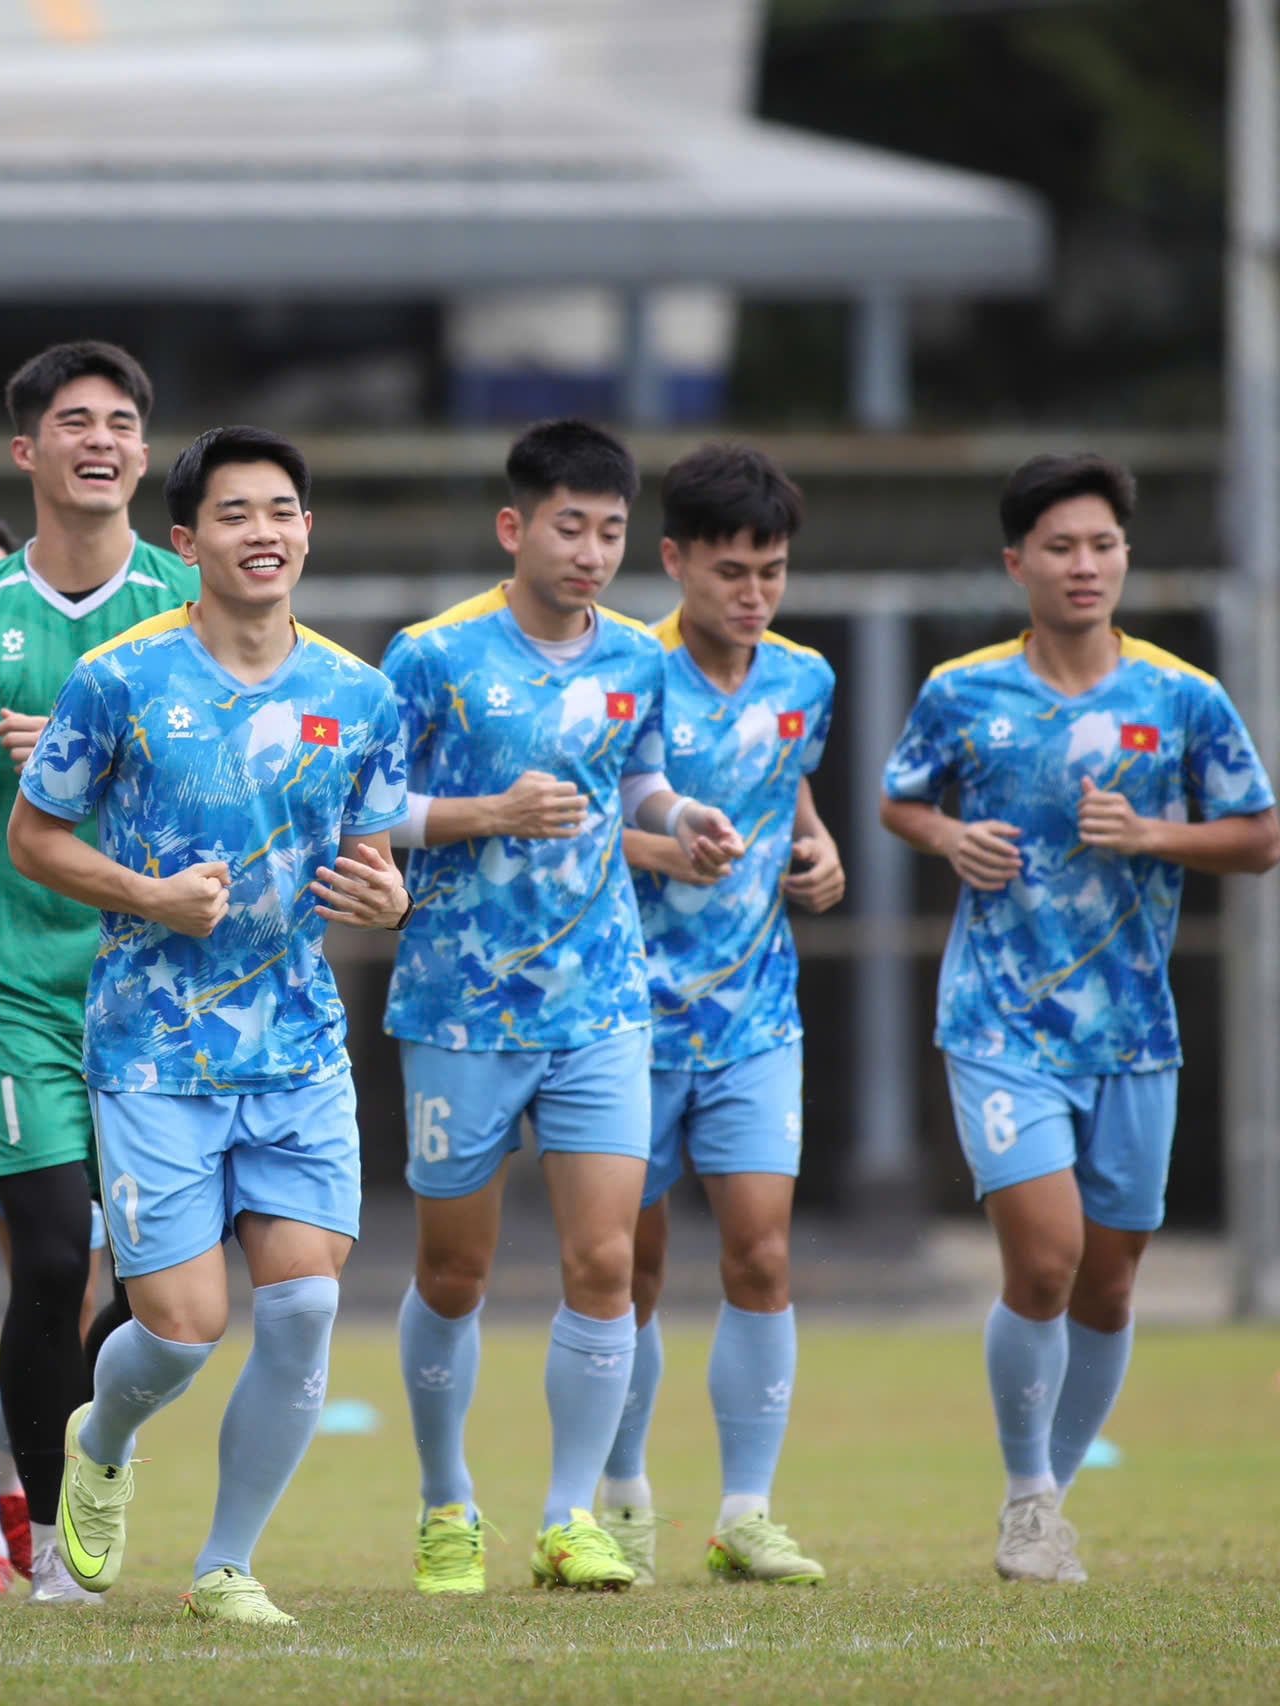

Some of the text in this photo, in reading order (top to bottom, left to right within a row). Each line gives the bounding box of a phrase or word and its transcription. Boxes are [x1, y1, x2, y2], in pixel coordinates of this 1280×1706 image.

[0, 1075, 20, 1145] 1
[412, 1091, 451, 1163] 16
[982, 1089, 1017, 1155] 8
